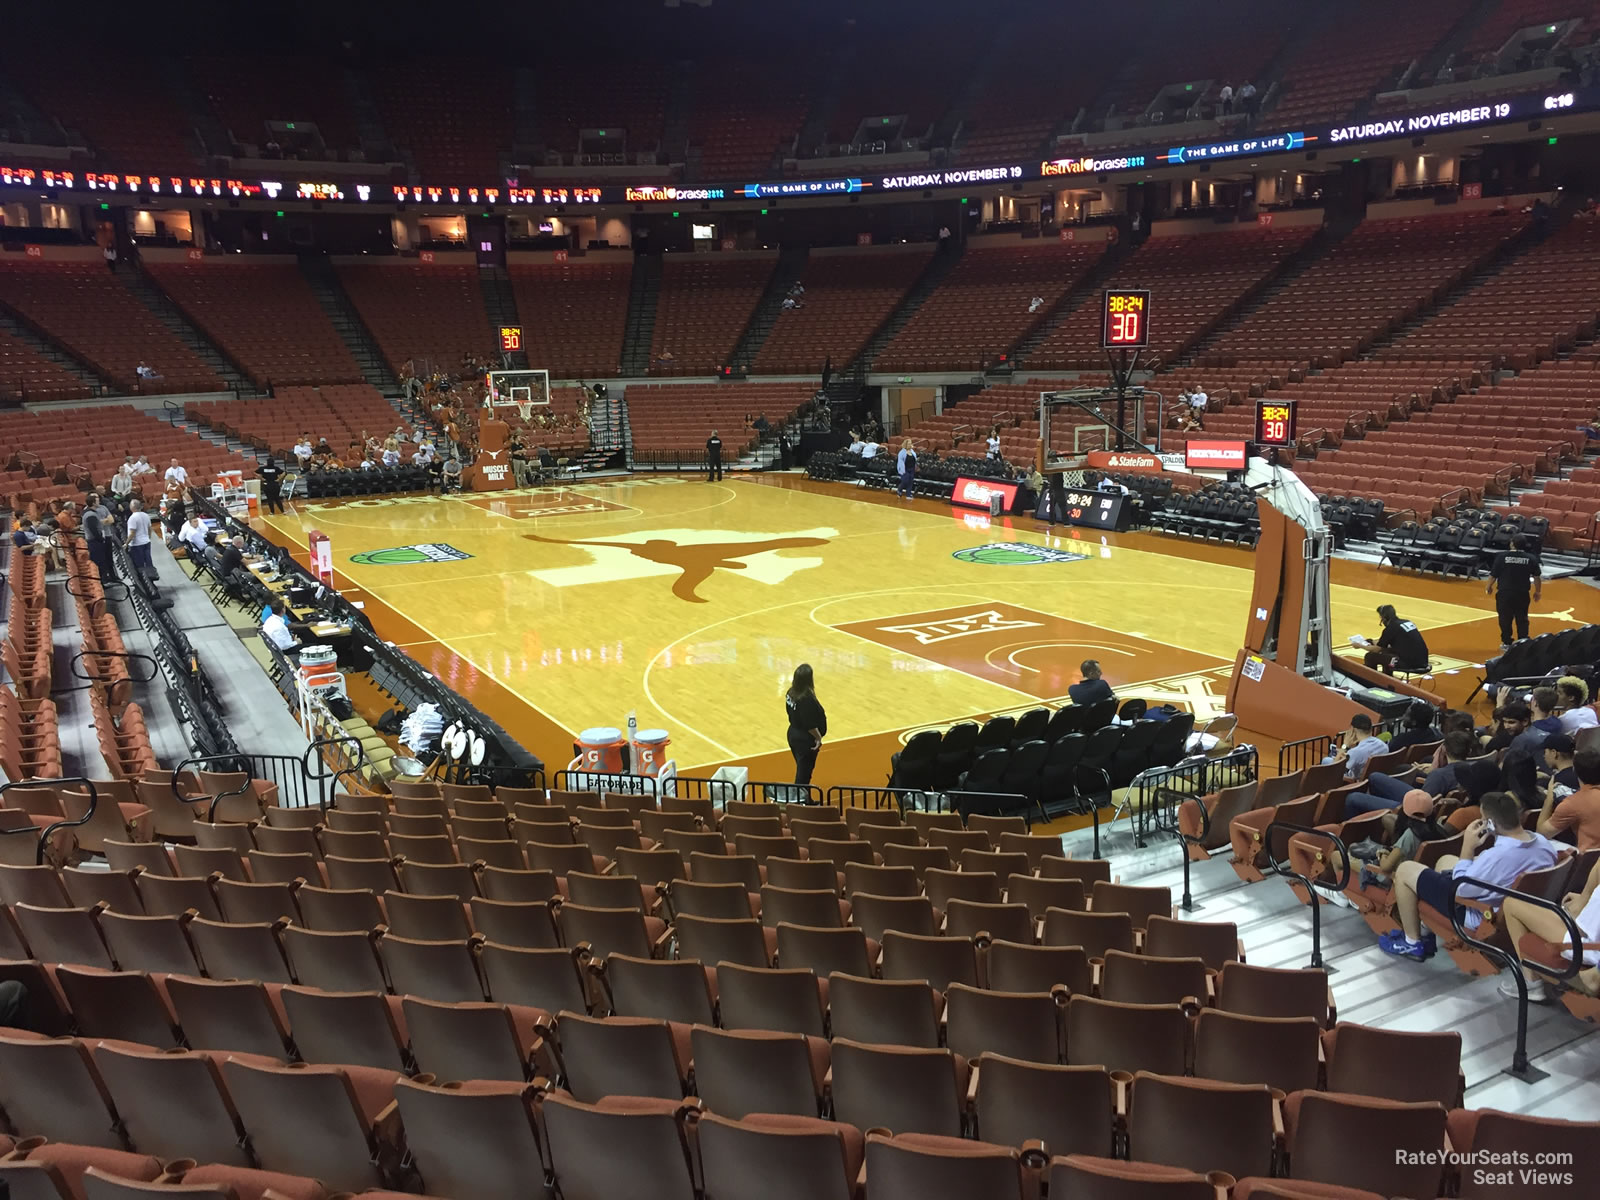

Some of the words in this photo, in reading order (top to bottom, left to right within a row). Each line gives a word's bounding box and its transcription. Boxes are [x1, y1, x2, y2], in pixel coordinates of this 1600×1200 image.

[1330, 119, 1405, 142] SATURDAY,
[1409, 106, 1490, 131] NOVEMBER
[1495, 103, 1510, 117] 19
[1187, 148, 1206, 157] THE
[1210, 144, 1239, 154] GAME
[1243, 141, 1257, 150] OF
[1261, 138, 1284, 149] LIFE
[1041, 157, 1084, 175] festival
[1094, 158, 1127, 172] praise
[883, 173, 942, 188] SATURDAY,
[945, 167, 1007, 183] NOVEMBER
[1010, 166, 1022, 177] 19
[626, 187, 667, 200] festival
[676, 189, 708, 200] praise
[782, 185, 807, 193] GAME
[810, 183, 822, 191] OF
[826, 182, 845, 190] LIFE
[1466, 186, 1479, 197] 36
[1260, 215, 1272, 225] 37
[1062, 231, 1073, 241] 38
[556, 253, 566, 261] 41
[1109, 296, 1143, 312] 38:24
[501, 328, 520, 336] 38:24
[1112, 313, 1138, 340] 30
[504, 335, 519, 349] 30
[1262, 406, 1289, 420] 38:24
[1266, 421, 1284, 439] 30
[1161, 455, 1185, 464] SPALDIN
[483, 464, 509, 474] MUSCLE
[488, 472, 505, 481] MILK
[1067, 493, 1093, 507] 38:24
[1071, 508, 1081, 518] 30
[1101, 511, 1108, 520] 0
[1505, 556, 1529, 564] SECURITY
[588, 750, 599, 763] G
[642, 750, 653, 763] G
